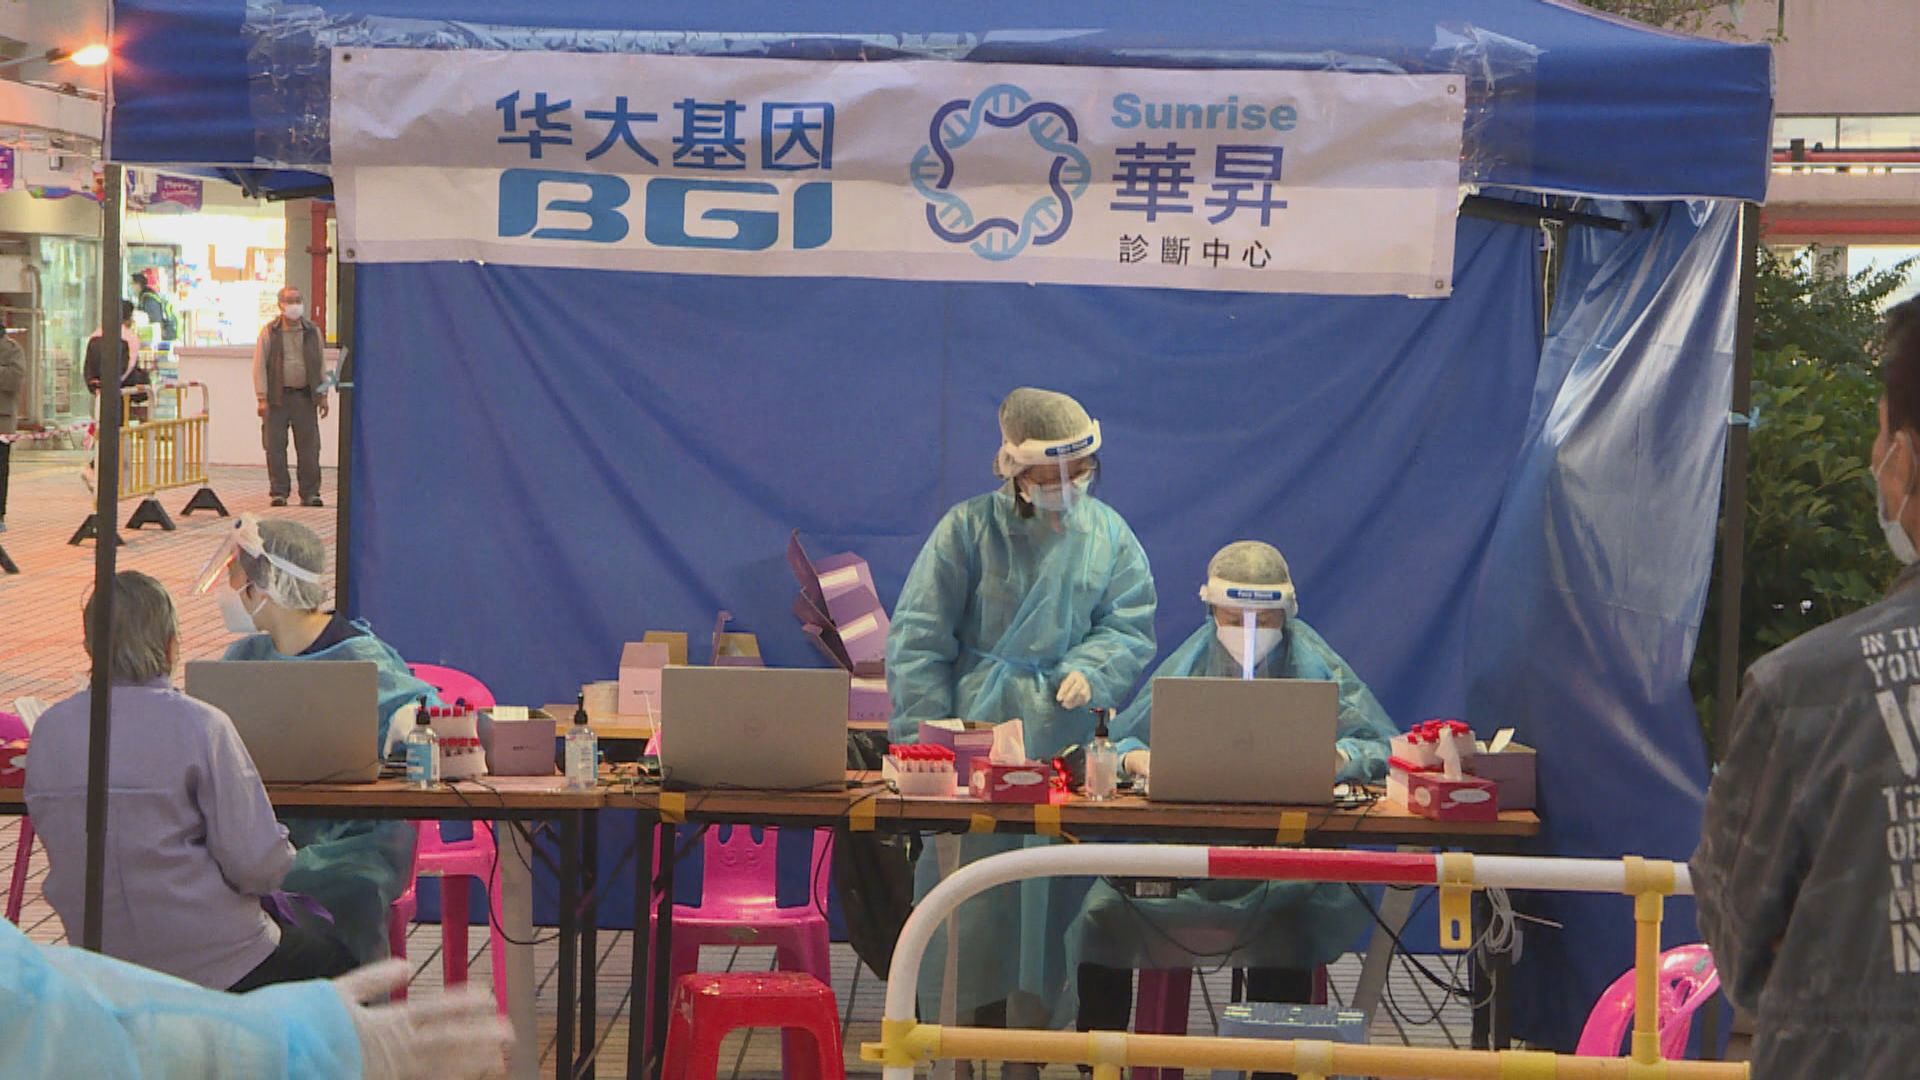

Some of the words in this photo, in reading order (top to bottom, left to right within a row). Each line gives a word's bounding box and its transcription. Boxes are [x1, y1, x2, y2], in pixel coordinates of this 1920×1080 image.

[496, 90, 835, 170] 华大基因
[1111, 92, 1297, 131] Sunrise
[498, 168, 833, 251] BGI
[1110, 142, 1287, 227] 華昇
[1119, 234, 1271, 269] 診斷中心
